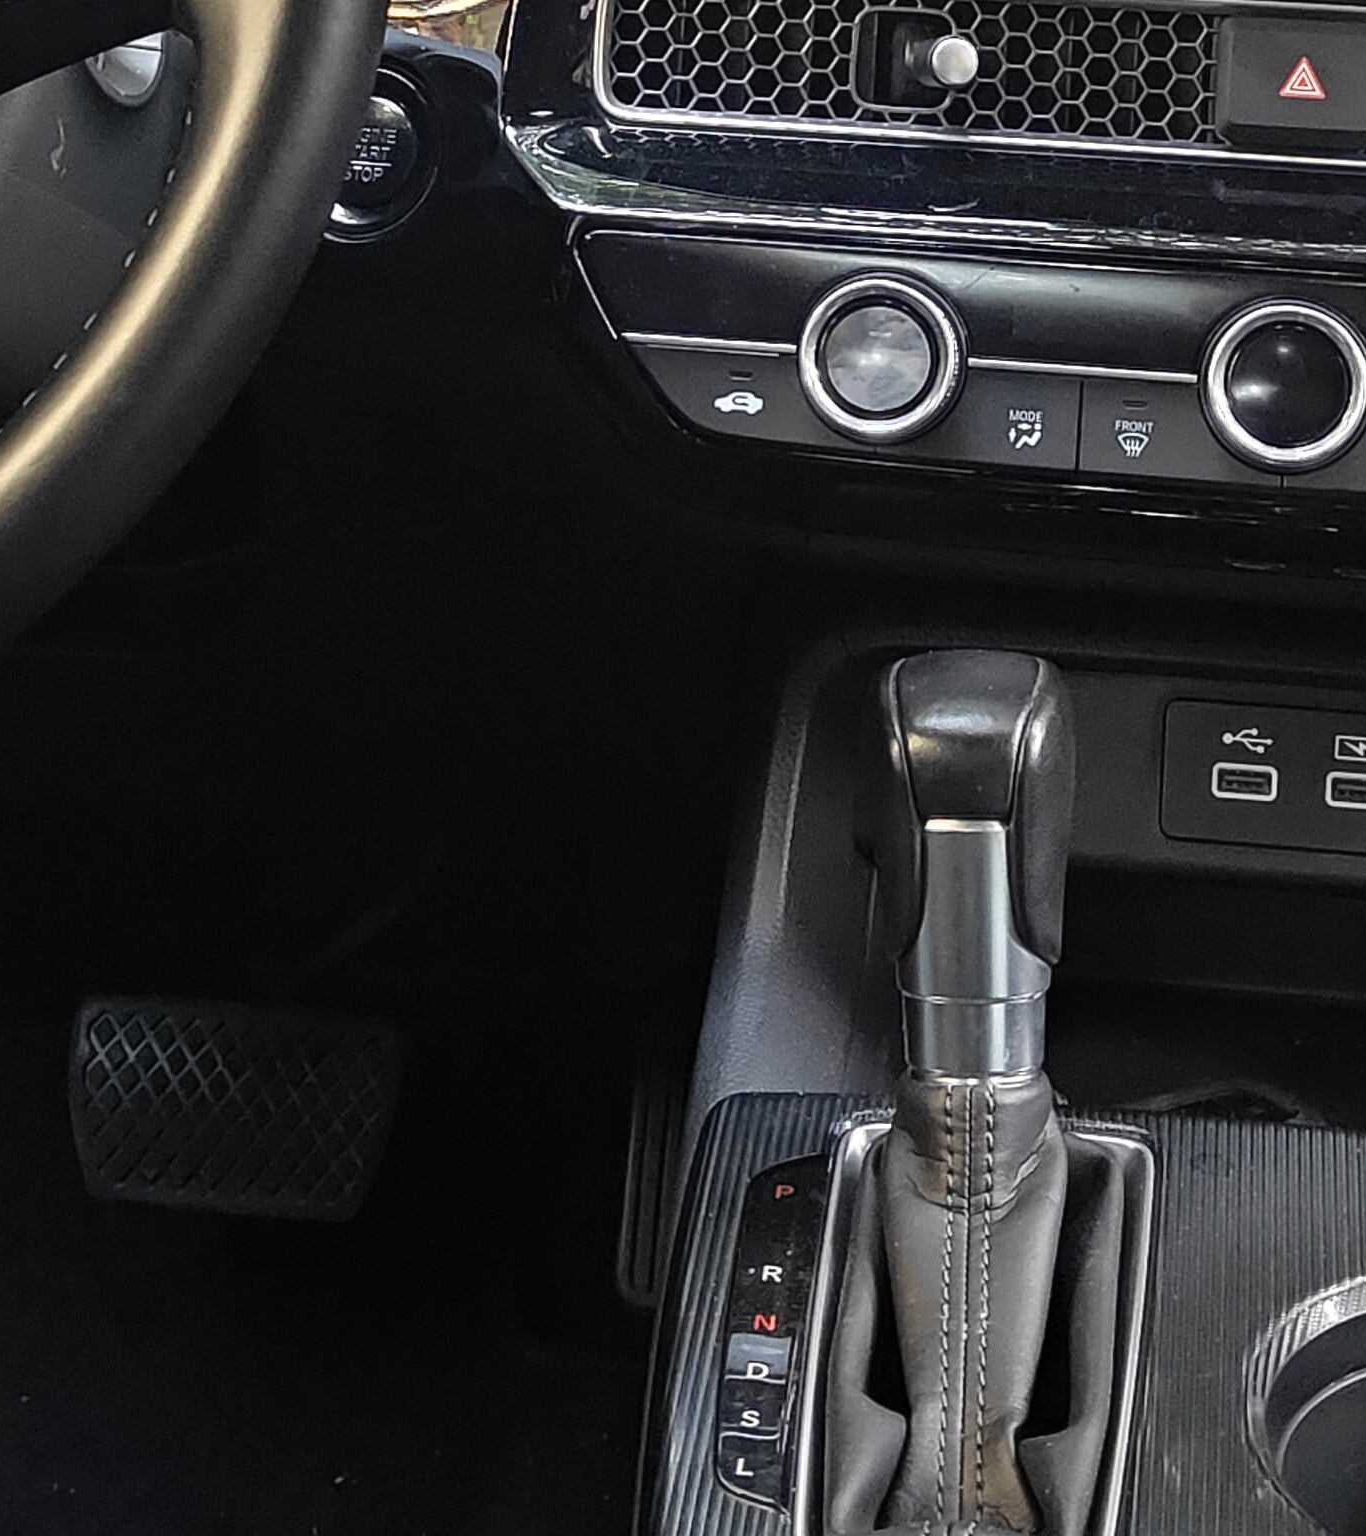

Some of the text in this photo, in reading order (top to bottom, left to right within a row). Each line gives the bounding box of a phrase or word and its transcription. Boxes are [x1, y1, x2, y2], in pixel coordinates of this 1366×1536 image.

[359, 127, 398, 145] GINE
[1008, 409, 1044, 424] MODE
[1114, 419, 1154, 434] FRONT
[775, 1184, 795, 1200] P
[761, 1265, 783, 1283] R
[753, 1314, 777, 1332] N
[746, 1362, 769, 1380] D
[739, 1409, 761, 1428] S
[734, 1457, 755, 1477] L
